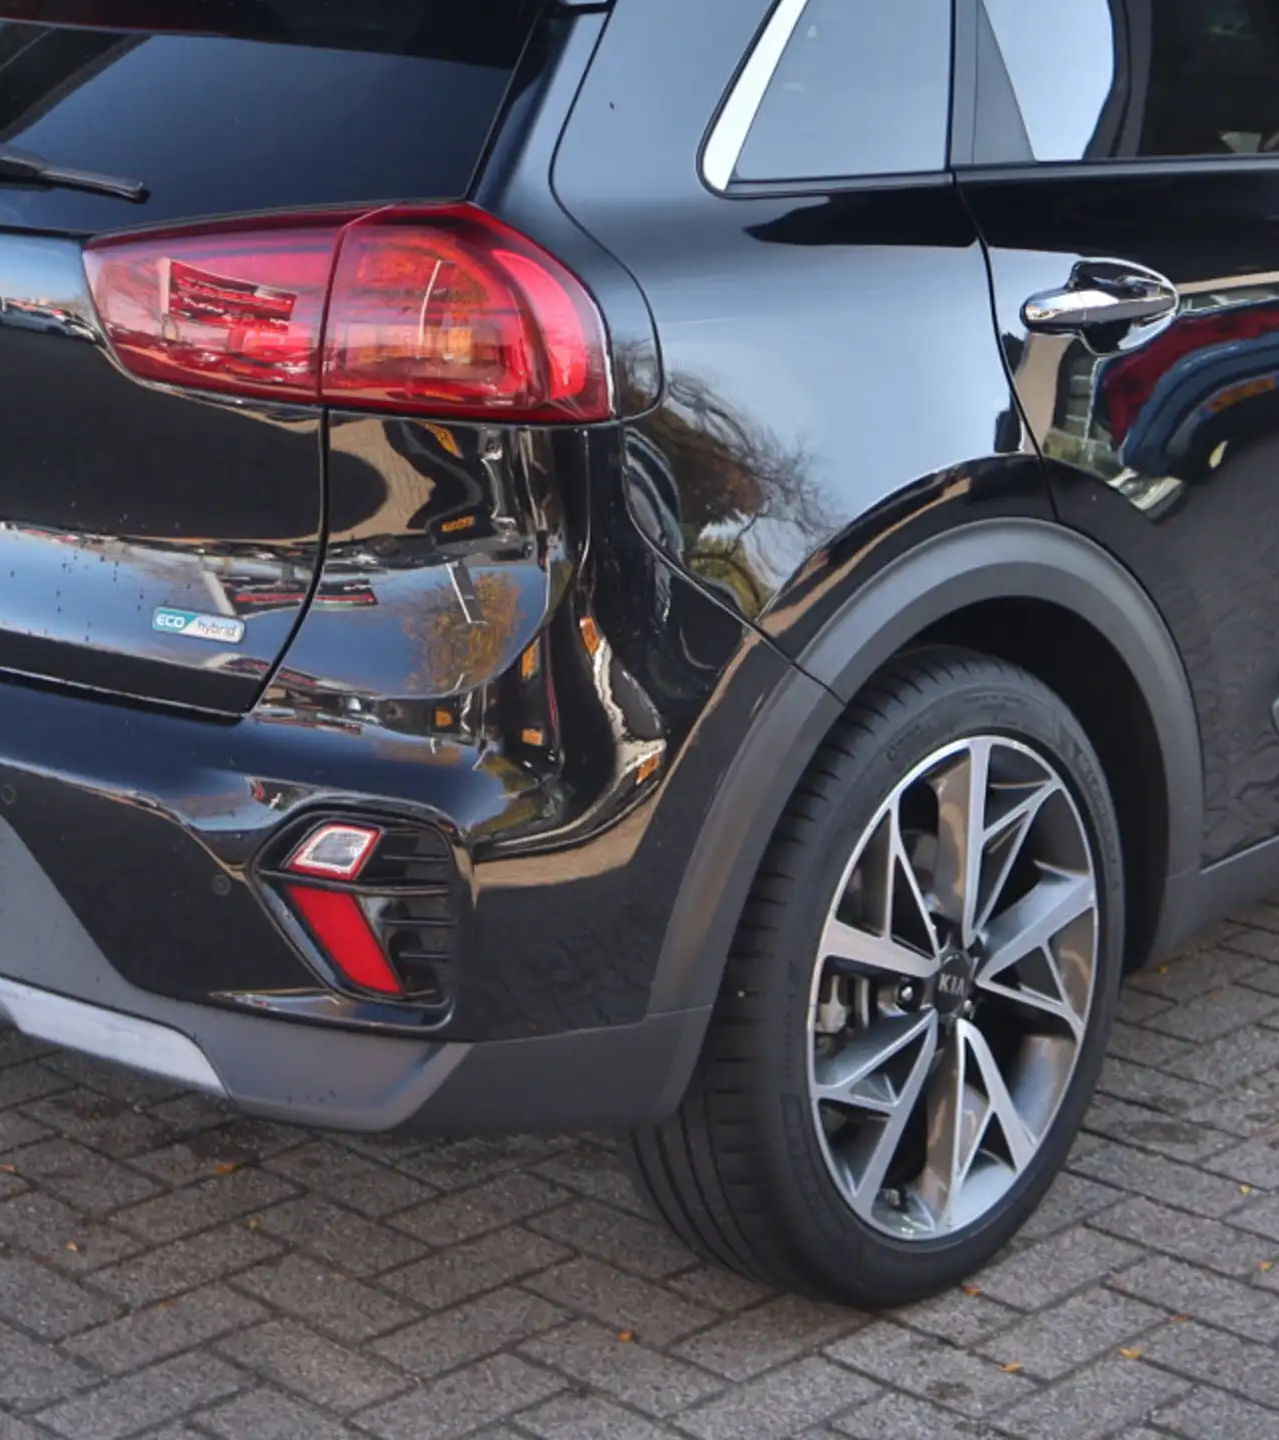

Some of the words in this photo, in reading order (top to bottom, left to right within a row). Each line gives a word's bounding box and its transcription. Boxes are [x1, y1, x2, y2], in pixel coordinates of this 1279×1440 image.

[155, 613, 186, 629] ECO
[197, 619, 238, 637] hybrid
[938, 972, 967, 998] KIA
